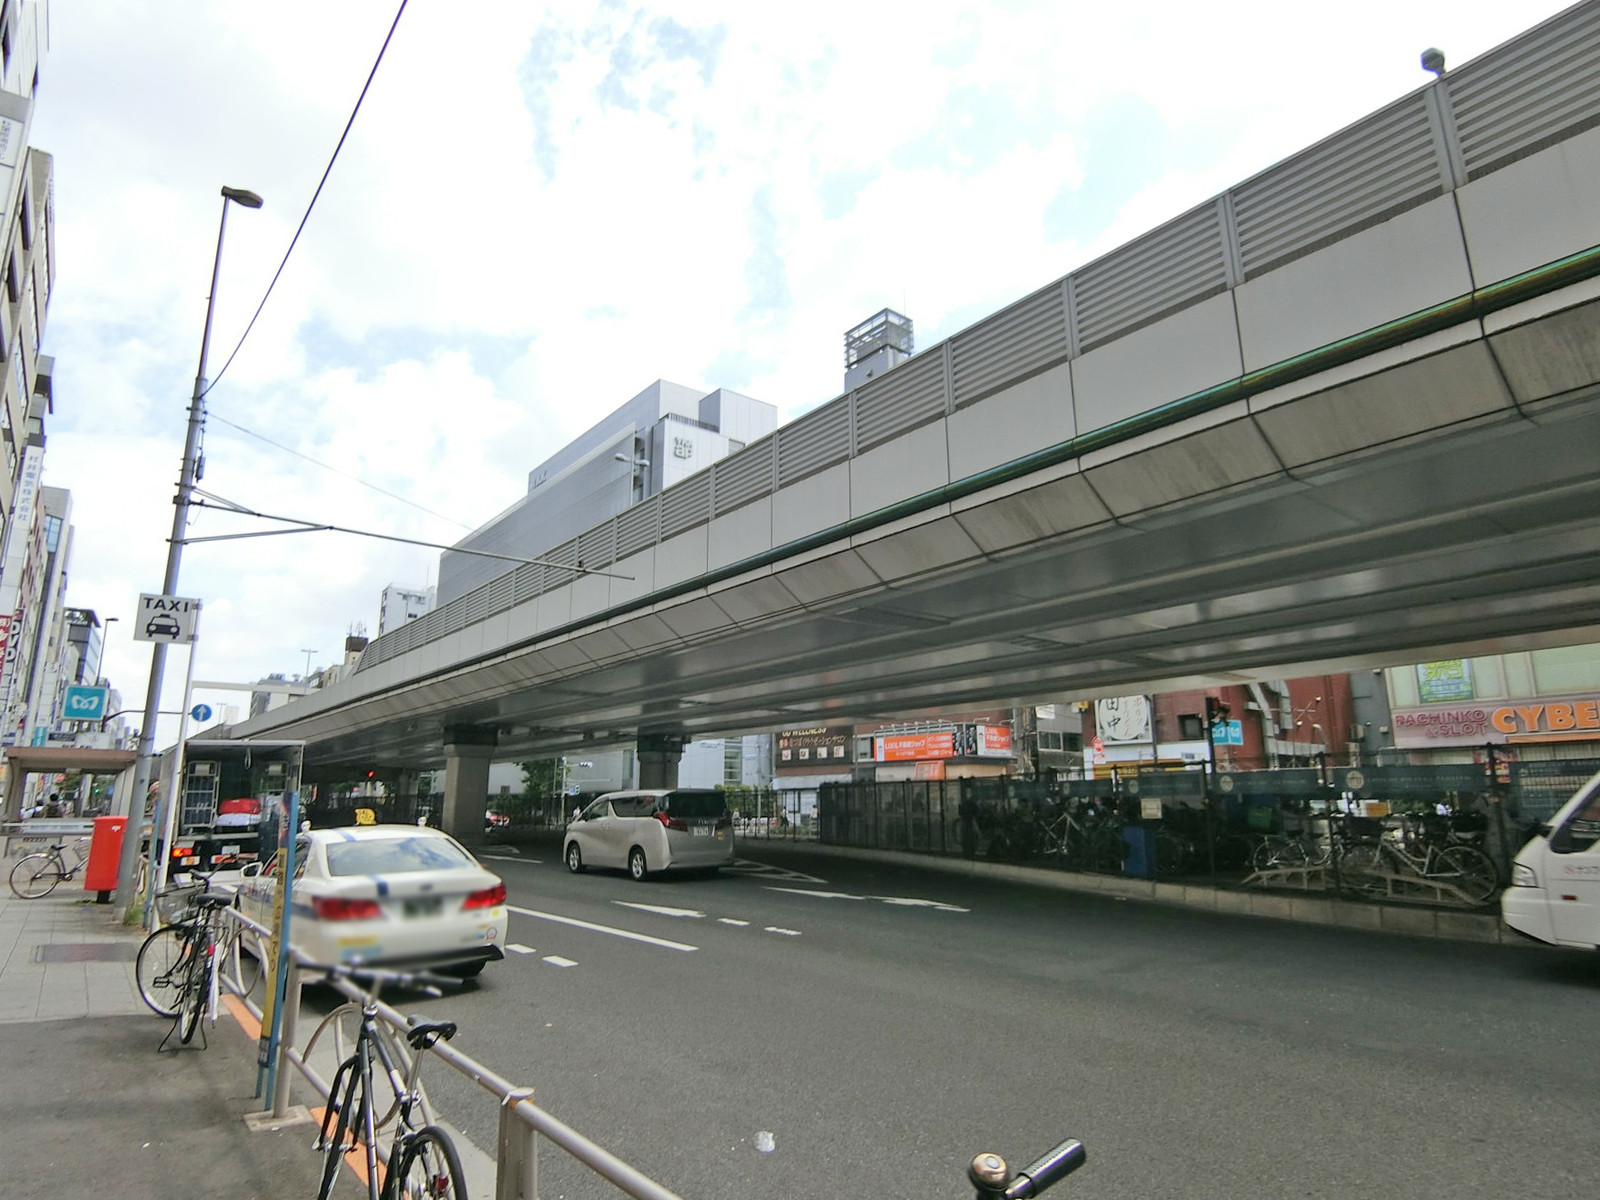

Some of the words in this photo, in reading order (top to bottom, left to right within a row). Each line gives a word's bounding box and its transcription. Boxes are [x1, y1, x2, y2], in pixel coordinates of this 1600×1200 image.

[144, 597, 189, 612] TAXI
[1394, 710, 1486, 727] PACHINKO
[1492, 701, 1600, 734] CYBE
